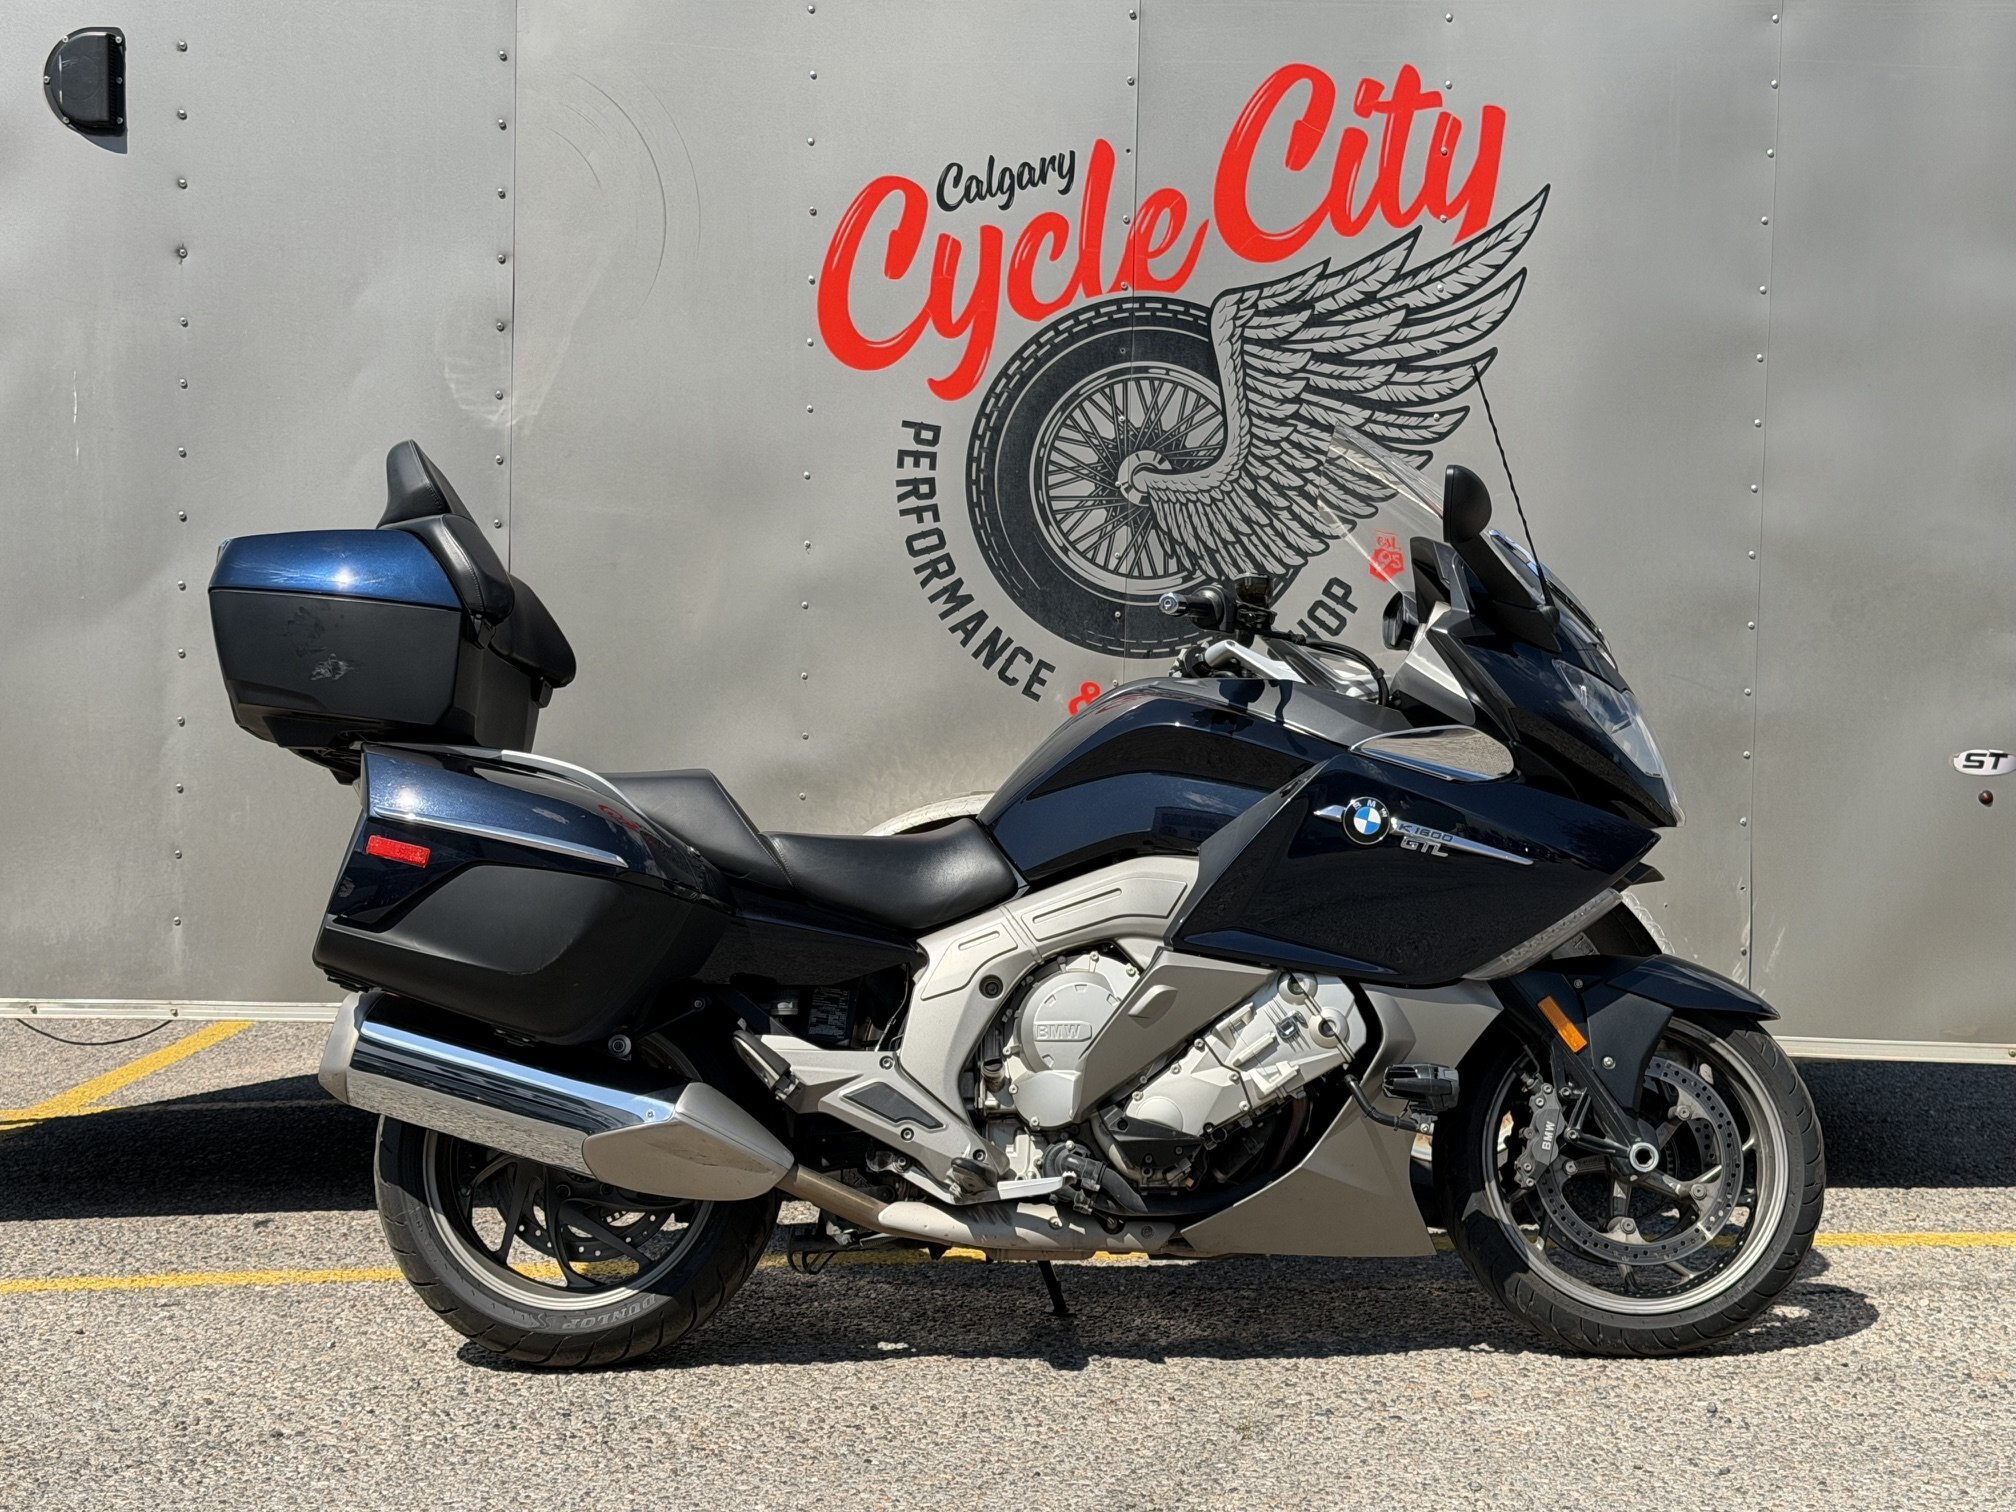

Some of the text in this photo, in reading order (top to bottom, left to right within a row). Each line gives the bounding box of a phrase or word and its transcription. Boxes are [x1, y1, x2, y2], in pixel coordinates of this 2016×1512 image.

[936, 150, 1076, 212] Calgary
[817, 63, 1506, 401] Cycle City
[895, 420, 1056, 702] PERFORMANCE
[1962, 752, 2009, 770] ST
[1352, 799, 1388, 818] BMW
[1400, 836, 1449, 857] GTL
[1414, 827, 1454, 842] 1600
[1036, 1024, 1081, 1040] BMW
[1541, 1120, 1556, 1151] BMW
[561, 1293, 657, 1330] DUNLOP
